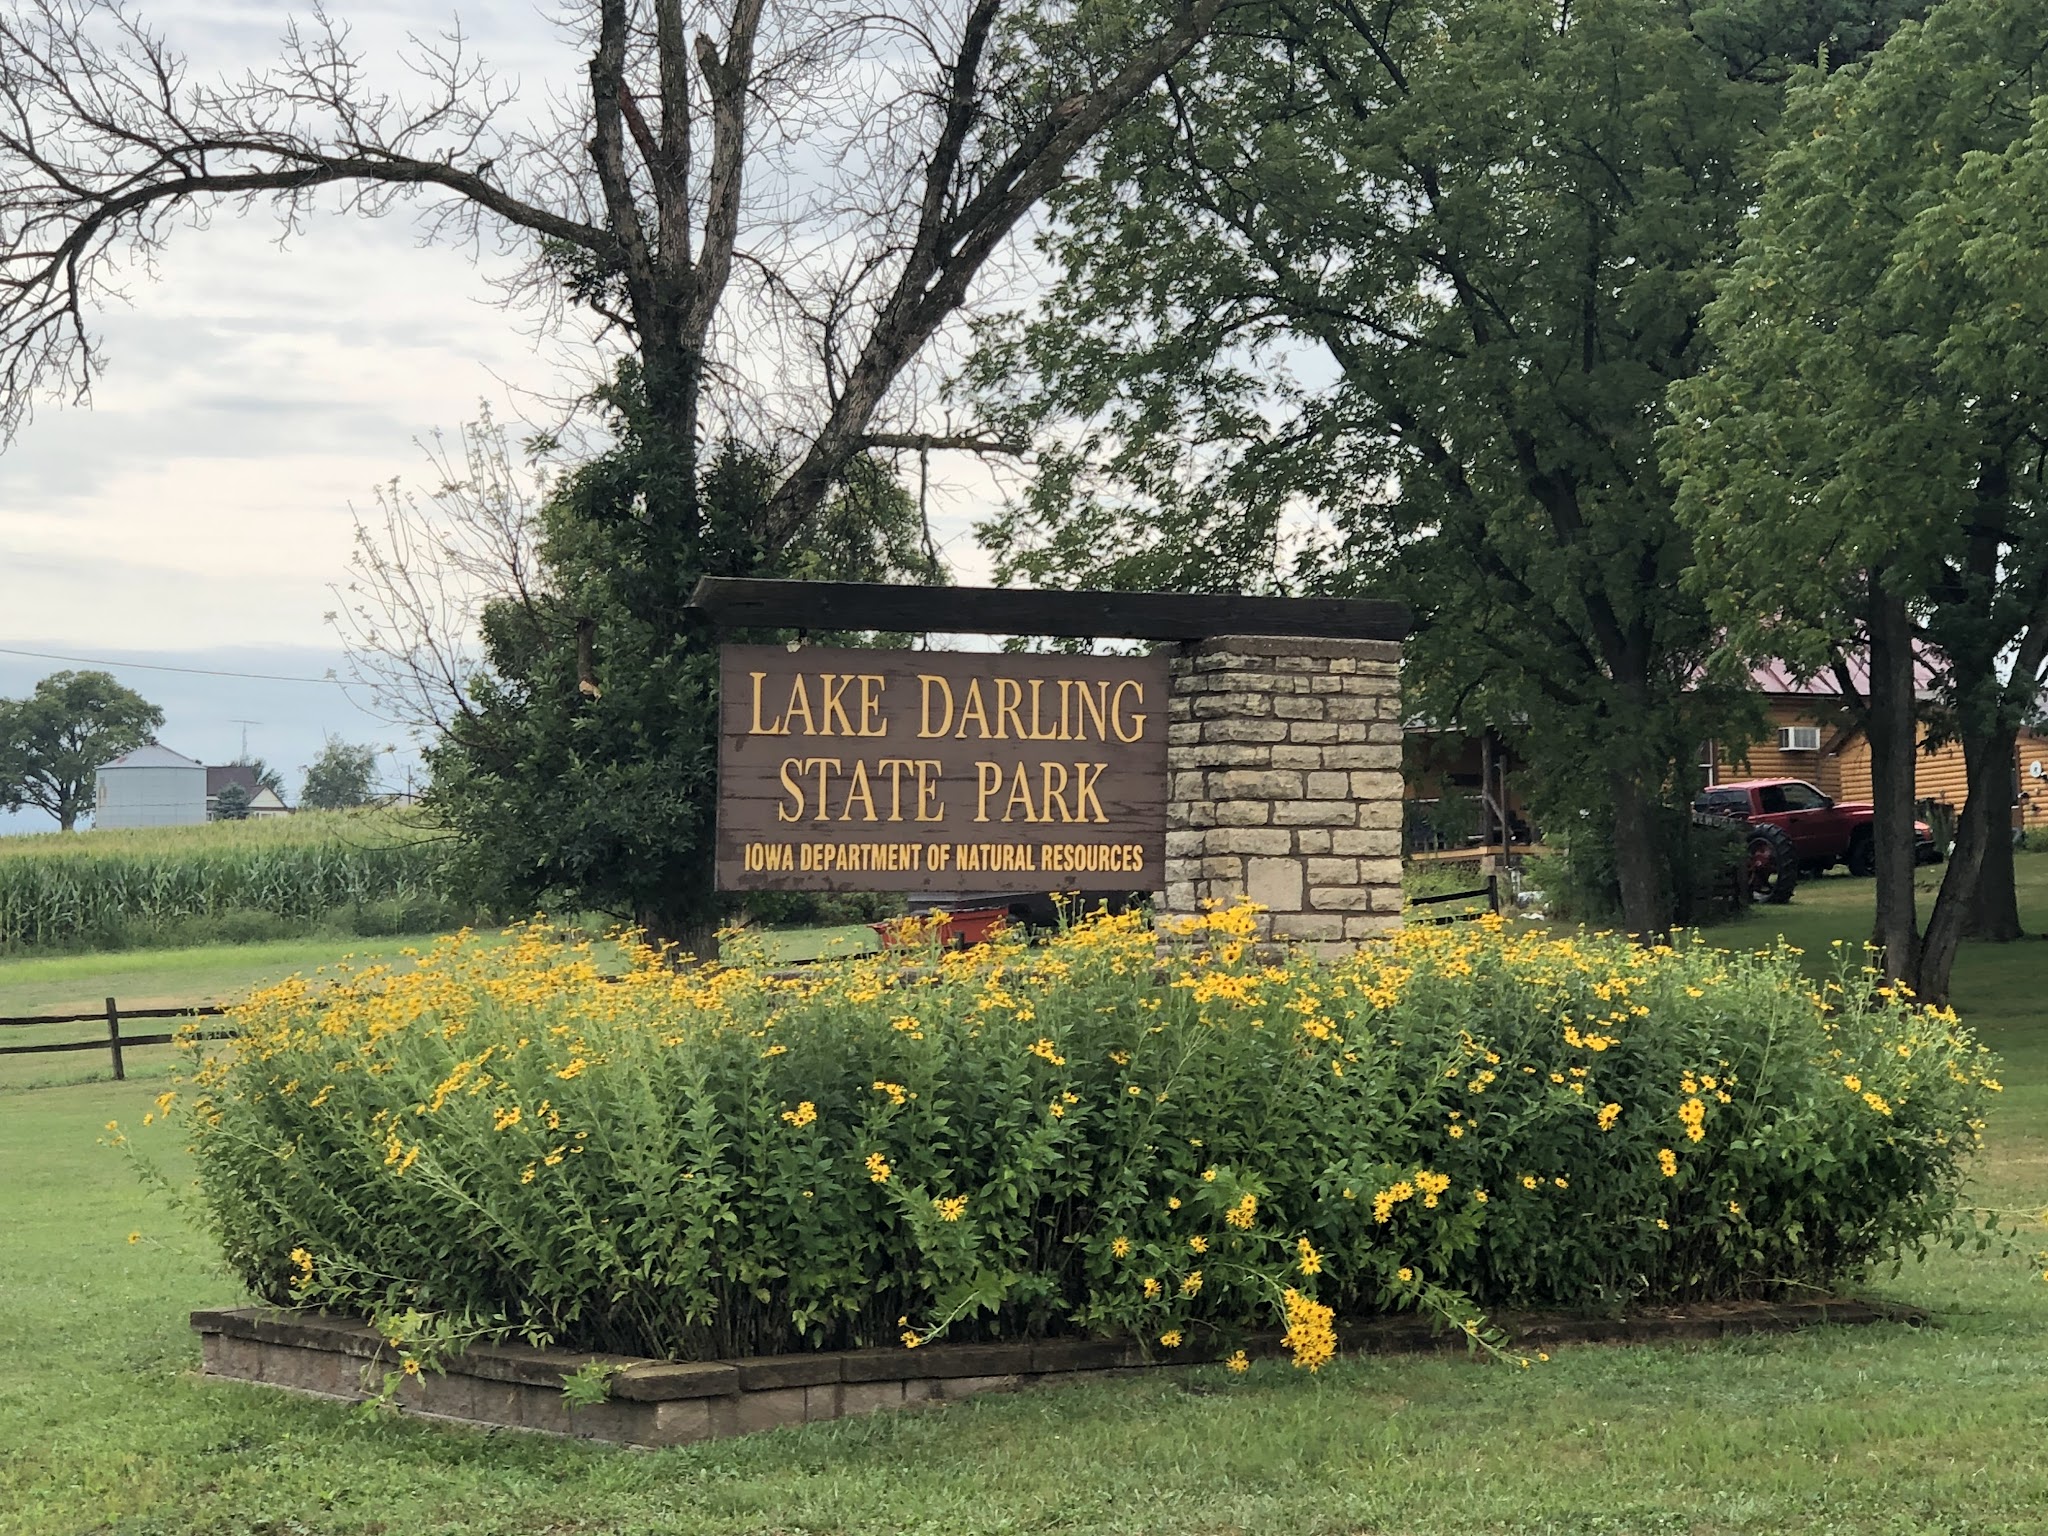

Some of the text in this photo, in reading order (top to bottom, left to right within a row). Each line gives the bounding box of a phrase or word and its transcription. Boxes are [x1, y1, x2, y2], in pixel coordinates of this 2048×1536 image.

[748, 671, 1147, 743] LAKE DARLING
[778, 757, 1110, 824] STATE PARK
[744, 842, 1144, 872] IOWA DEPARTMENT OF NATURAL RESOURCES
